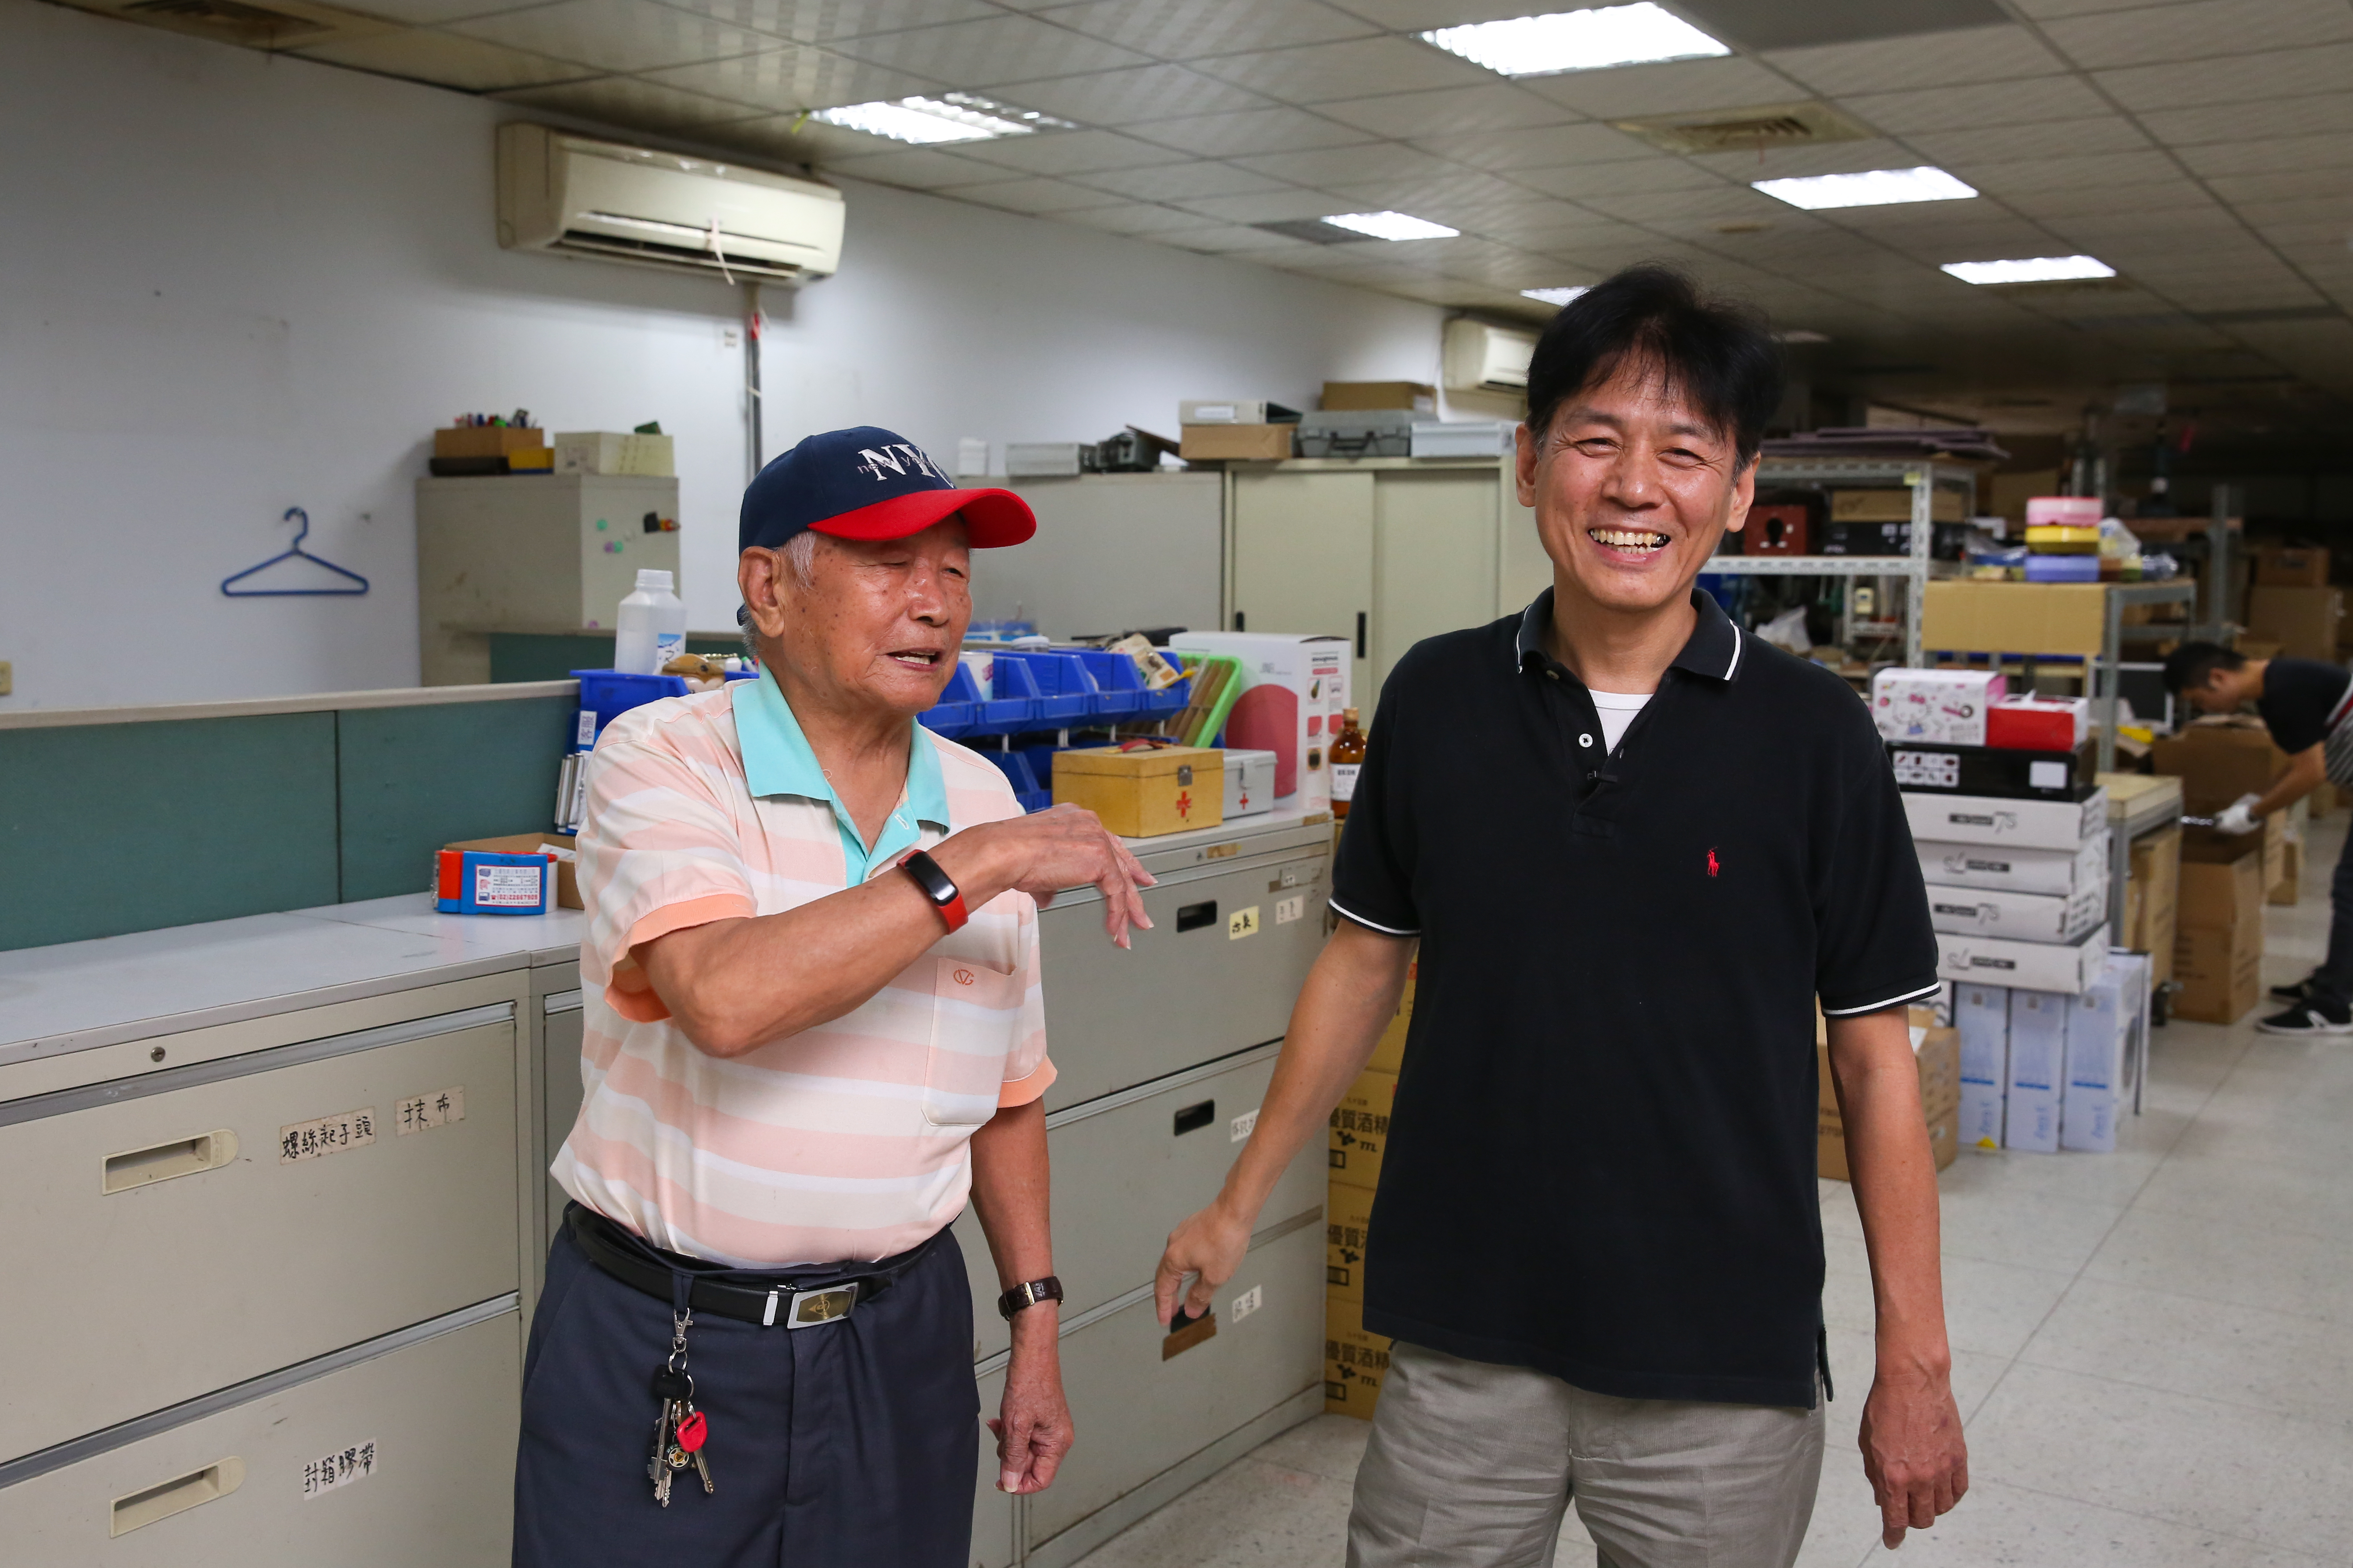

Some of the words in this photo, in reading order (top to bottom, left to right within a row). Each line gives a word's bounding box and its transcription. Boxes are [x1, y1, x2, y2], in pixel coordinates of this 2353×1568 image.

[404, 1093, 450, 1131] 抹布
[282, 1116, 373, 1159] 螺絲起子頭
[1328, 1223, 1367, 1249] 優質
[304, 1443, 375, 1492] 封箱膠帶
